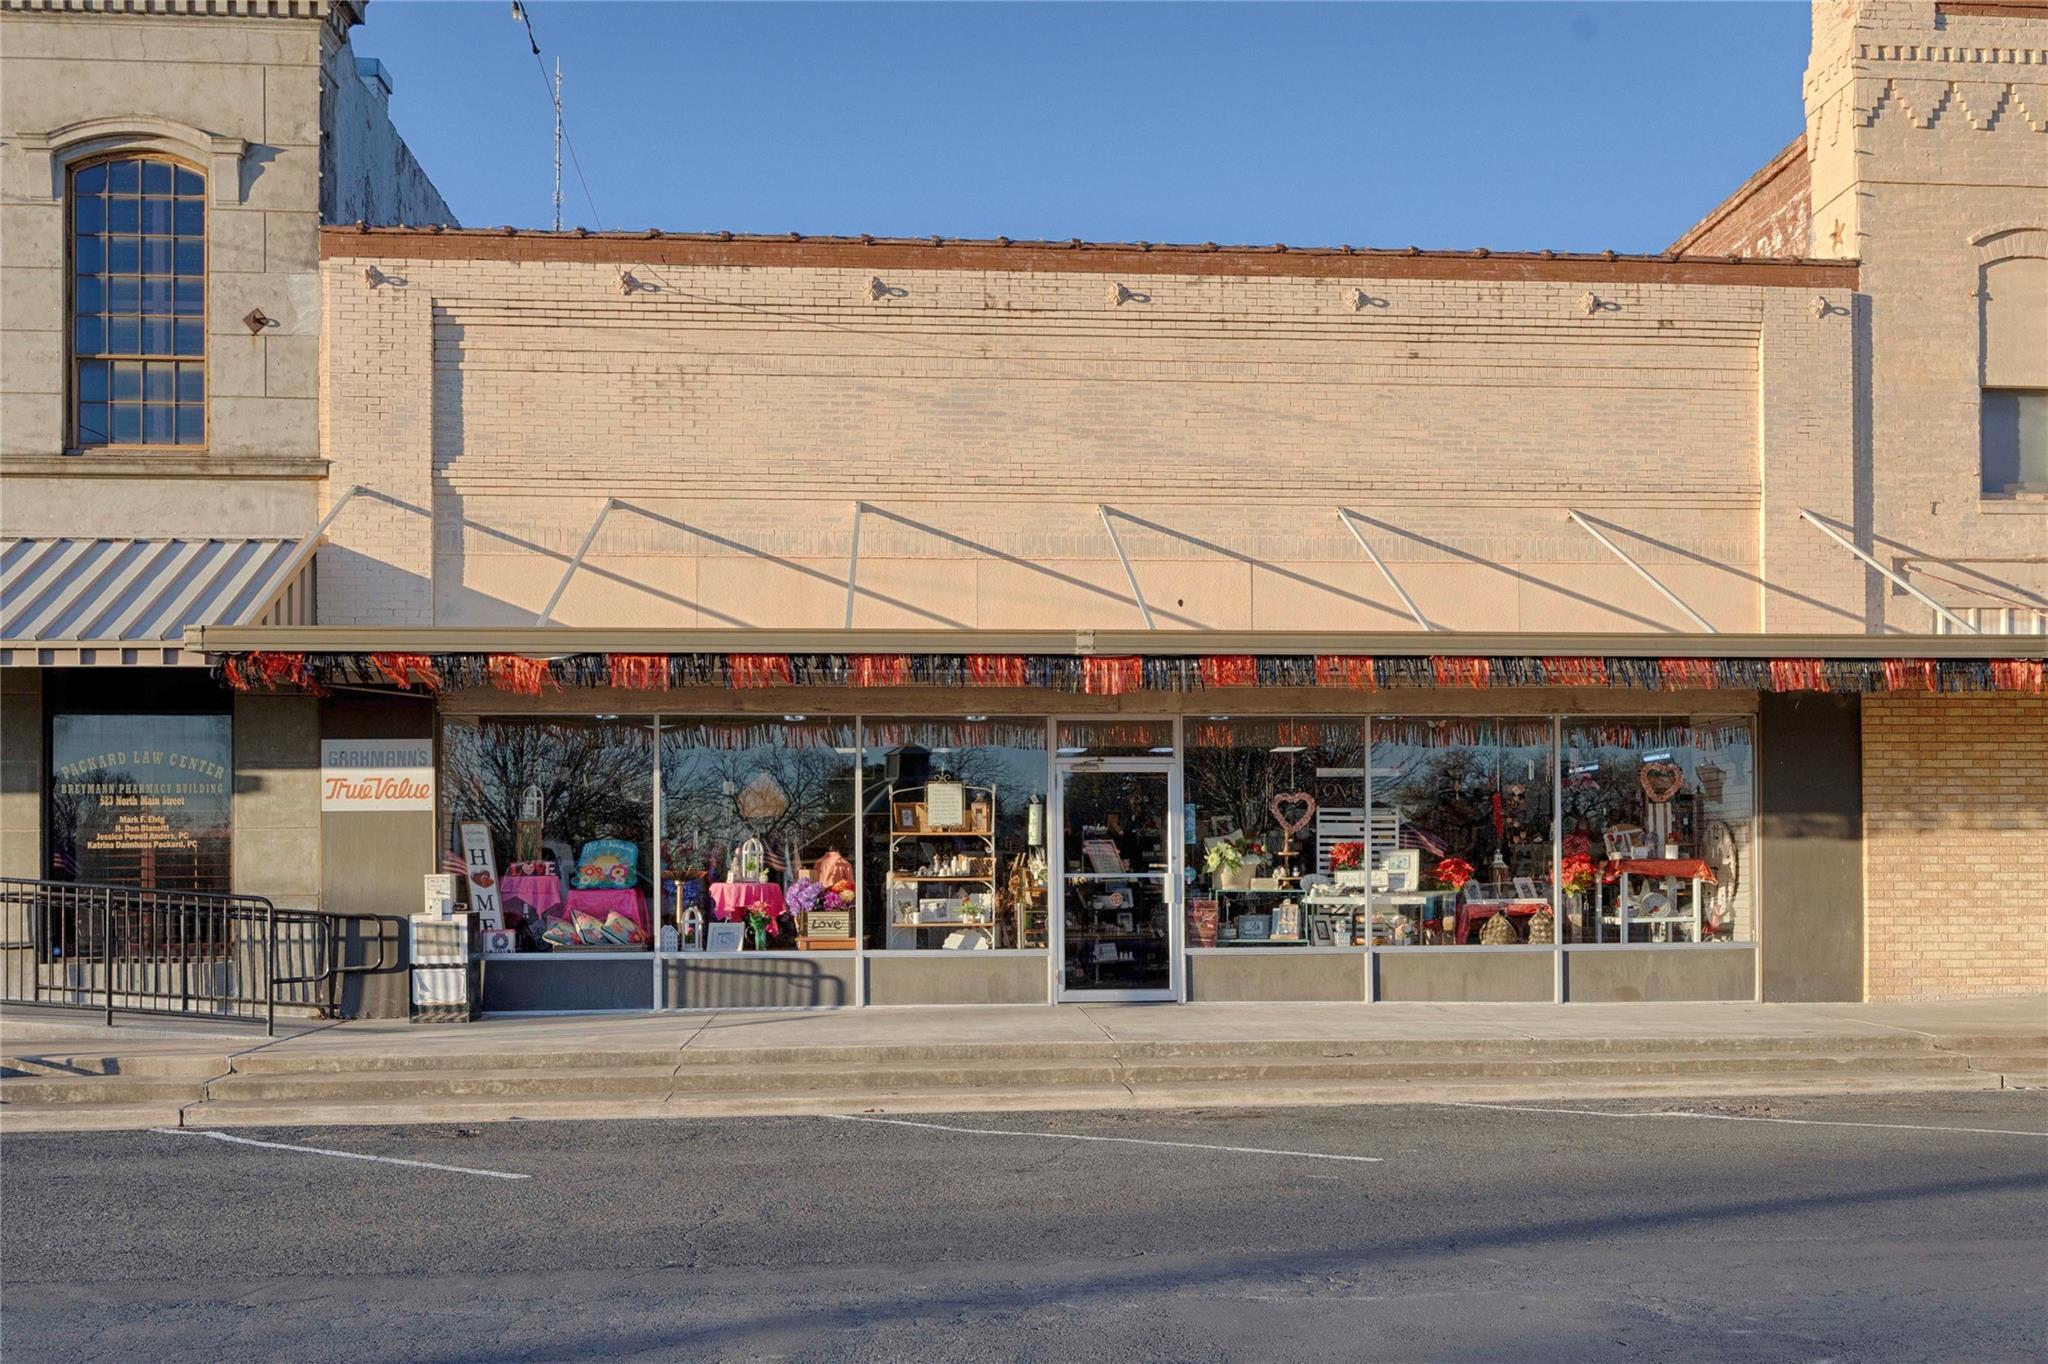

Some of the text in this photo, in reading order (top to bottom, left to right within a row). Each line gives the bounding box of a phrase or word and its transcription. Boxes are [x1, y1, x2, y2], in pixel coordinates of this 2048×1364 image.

[61, 751, 225, 780] PACKARD LAW CENTER
[61, 783, 224, 795] BREYMANN PHARMACY BUILDING
[326, 777, 430, 800] True Value
[100, 795, 185, 806] 523 North Main Street
[119, 815, 139, 823] Mark
[140, 815, 147, 823] F.
[125, 824, 140, 832] Don
[96, 833, 123, 841] Jessica
[178, 831, 190, 840] PC
[87, 841, 115, 849] Katrina
[153, 840, 186, 849] Packard,
[187, 840, 198, 849] PC
[811, 919, 843, 930] Love
